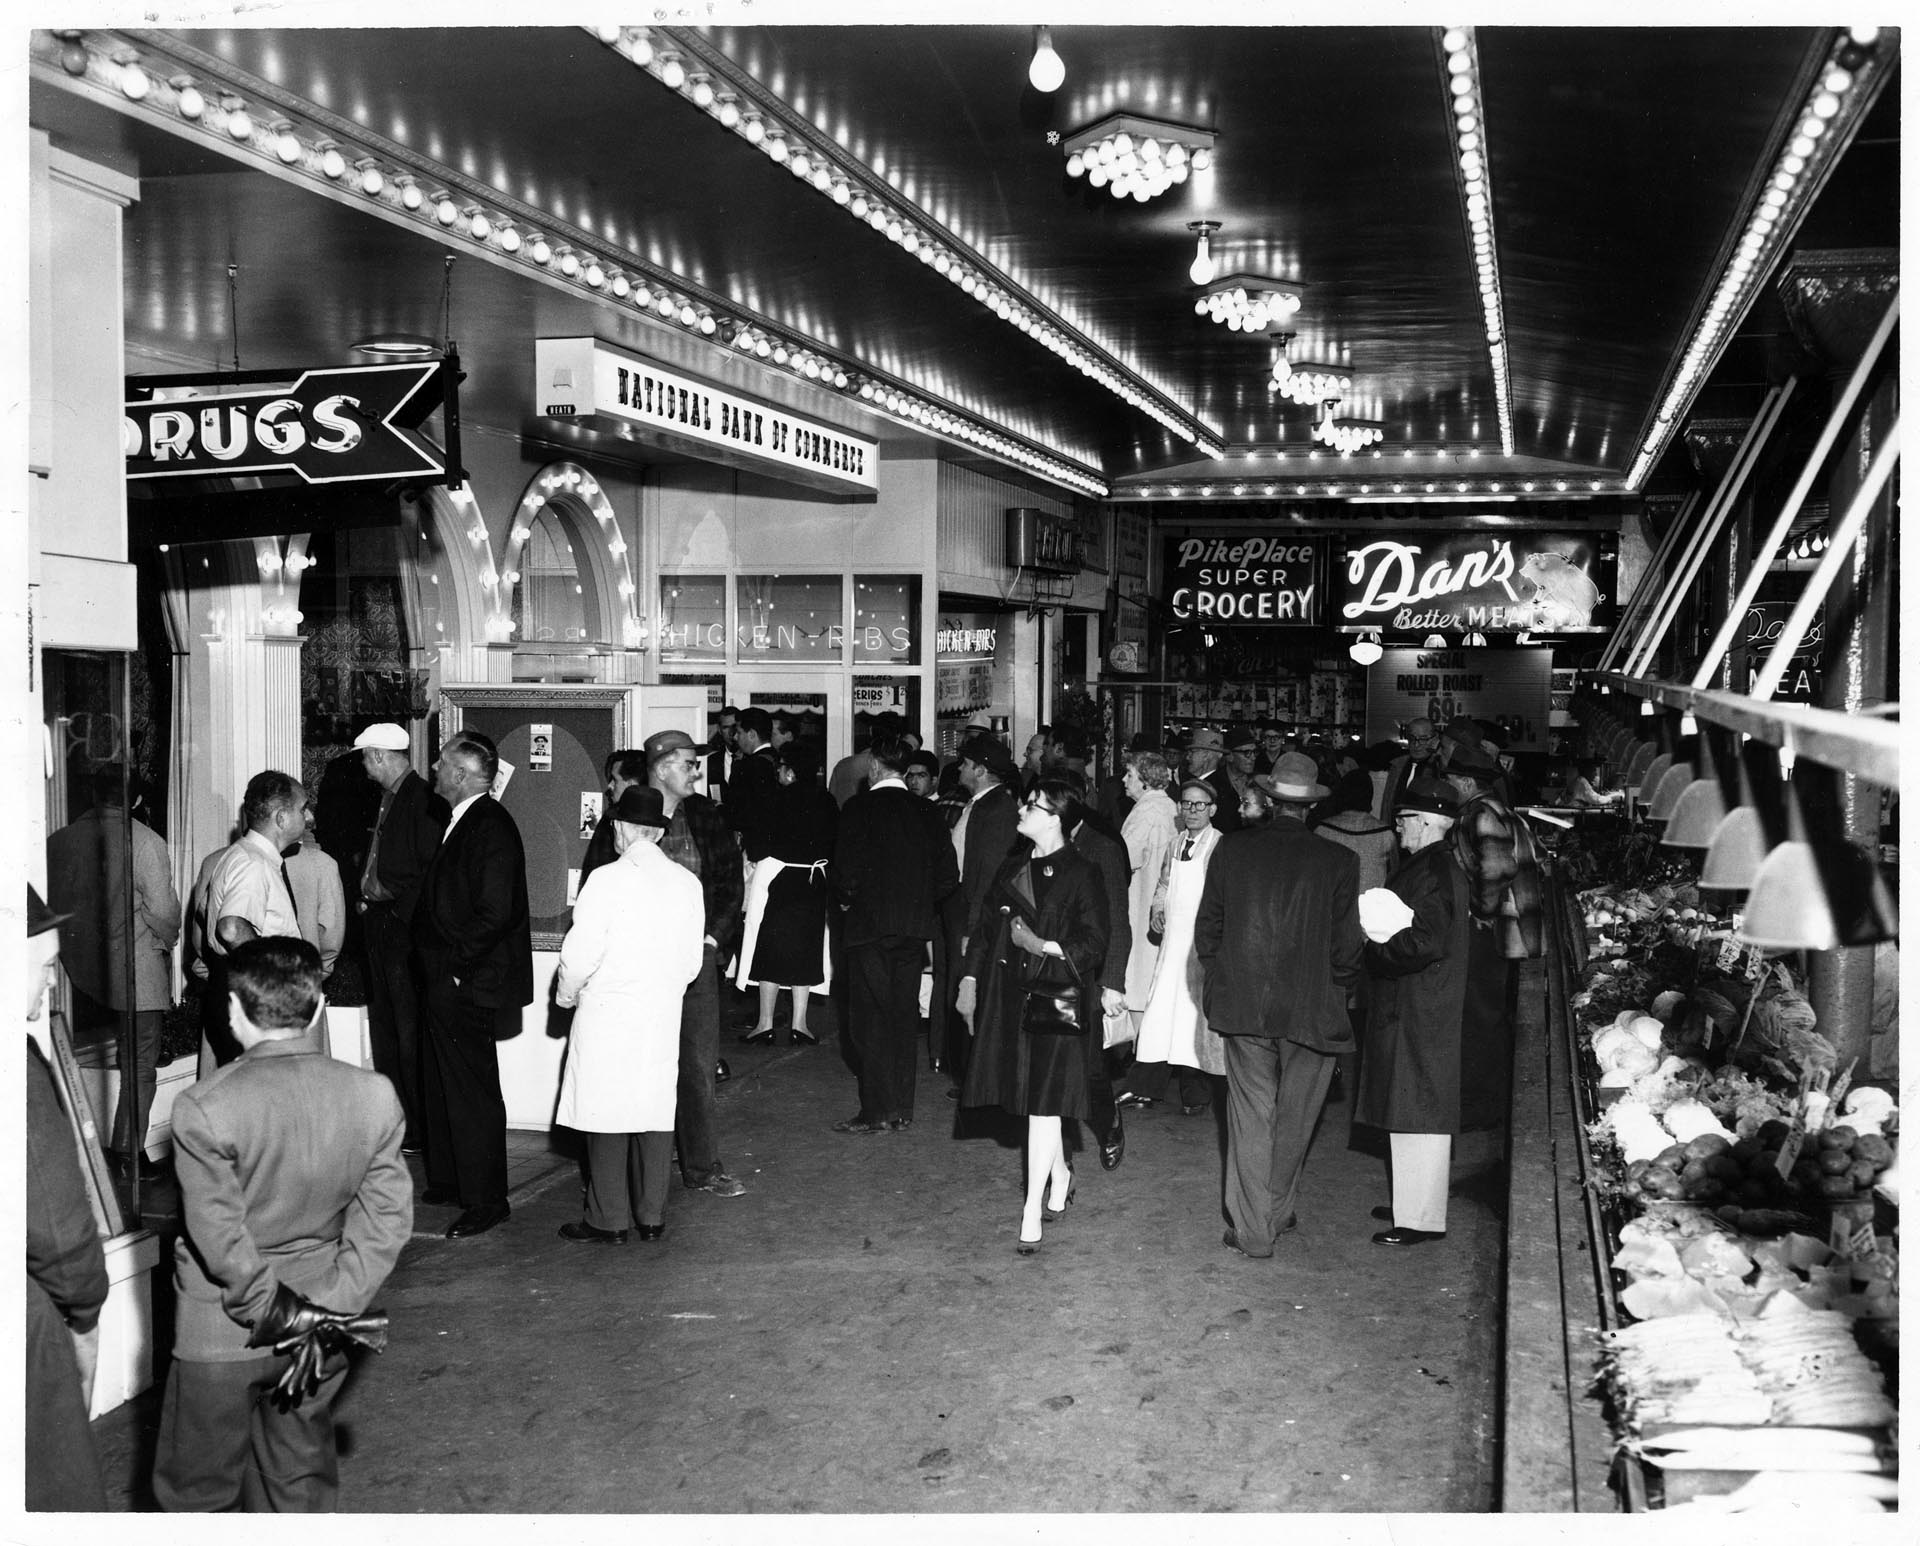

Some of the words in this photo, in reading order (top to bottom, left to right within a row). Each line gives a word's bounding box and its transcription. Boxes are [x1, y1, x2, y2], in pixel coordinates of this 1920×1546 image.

[617, 366, 712, 431] NATIONAL
[721, 402, 763, 446] BANK
[772, 419, 788, 453] OF
[795, 427, 863, 476] COMMERCE
[1199, 568, 1287, 586] SUPER
[1343, 539, 1519, 618] Dan's
[1172, 584, 1315, 619] GROCERY
[1393, 606, 1464, 629] Better
[1416, 653, 1466, 669] SPECIAL
[1397, 675, 1439, 691] ROLLED
[1443, 675, 1482, 691] ROAST
